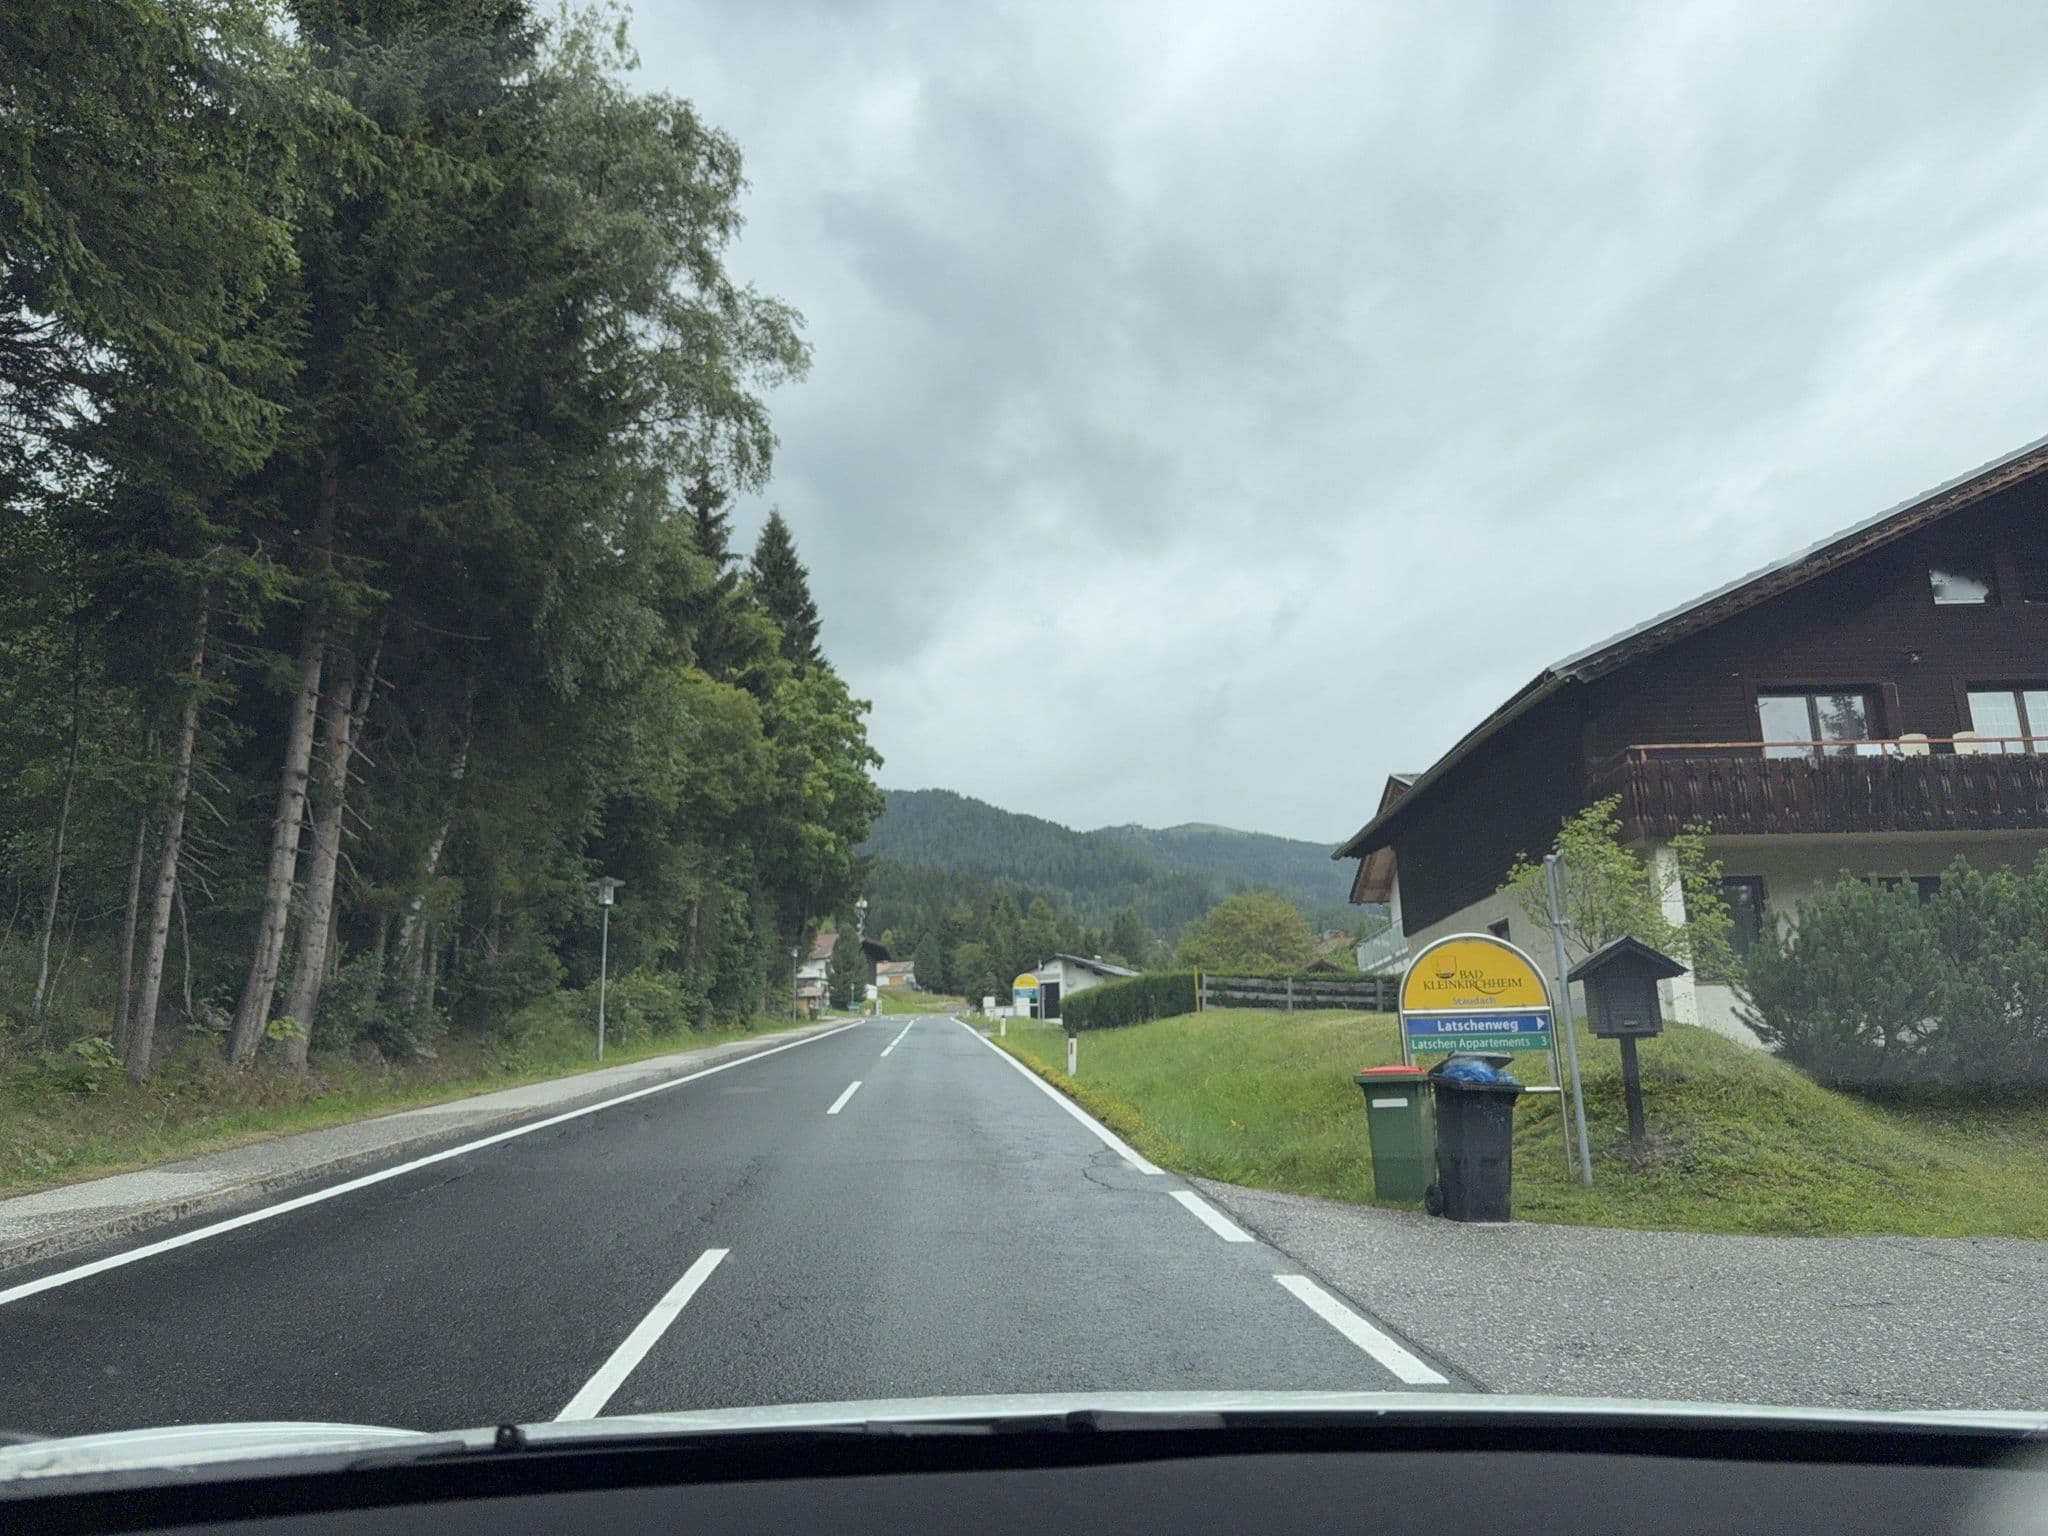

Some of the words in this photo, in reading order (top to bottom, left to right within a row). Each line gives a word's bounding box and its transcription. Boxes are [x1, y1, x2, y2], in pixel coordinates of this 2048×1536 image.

[1459, 969, 1484, 980] BAD
[1423, 977, 1522, 991] KLEINKIRCHHEIM
[1437, 1019, 1519, 1033] Latschenweg
[1411, 1037, 1457, 1050] Latschen
[1458, 1036, 1531, 1050] Appartements
[1540, 1036, 1547, 1047] 3
